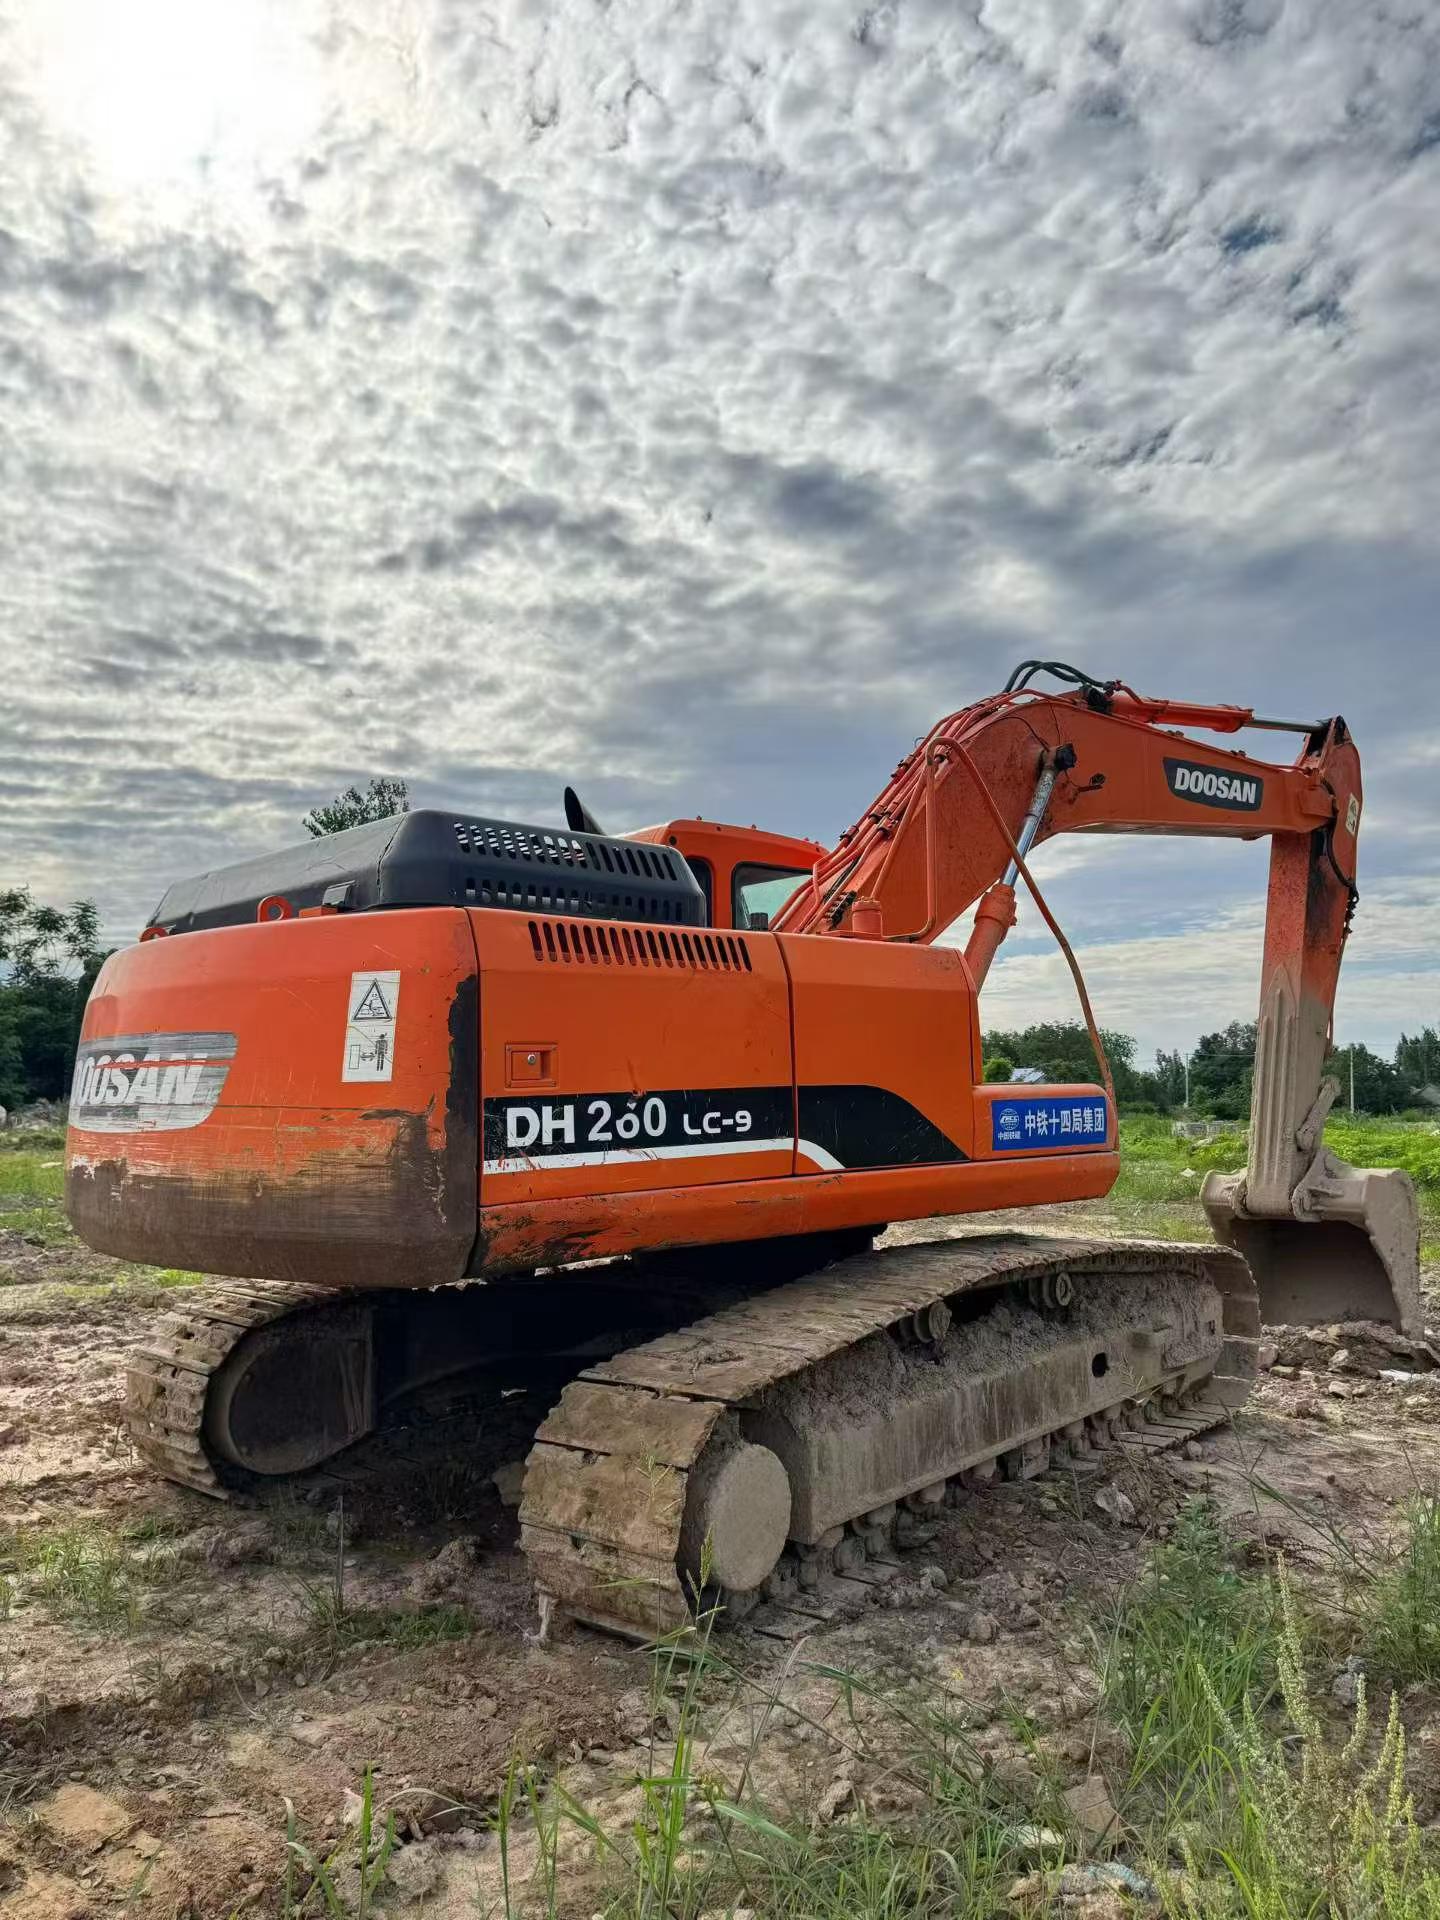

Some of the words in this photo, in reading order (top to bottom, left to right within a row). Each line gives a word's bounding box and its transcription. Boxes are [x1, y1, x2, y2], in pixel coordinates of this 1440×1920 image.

[1175, 767, 1257, 804] DOOSAN
[506, 1104, 576, 1148] DH
[587, 1097, 667, 1142] 260
[682, 1110, 752, 1135] LC-9
[1024, 1107, 1104, 1137] 中铁十四局集团
